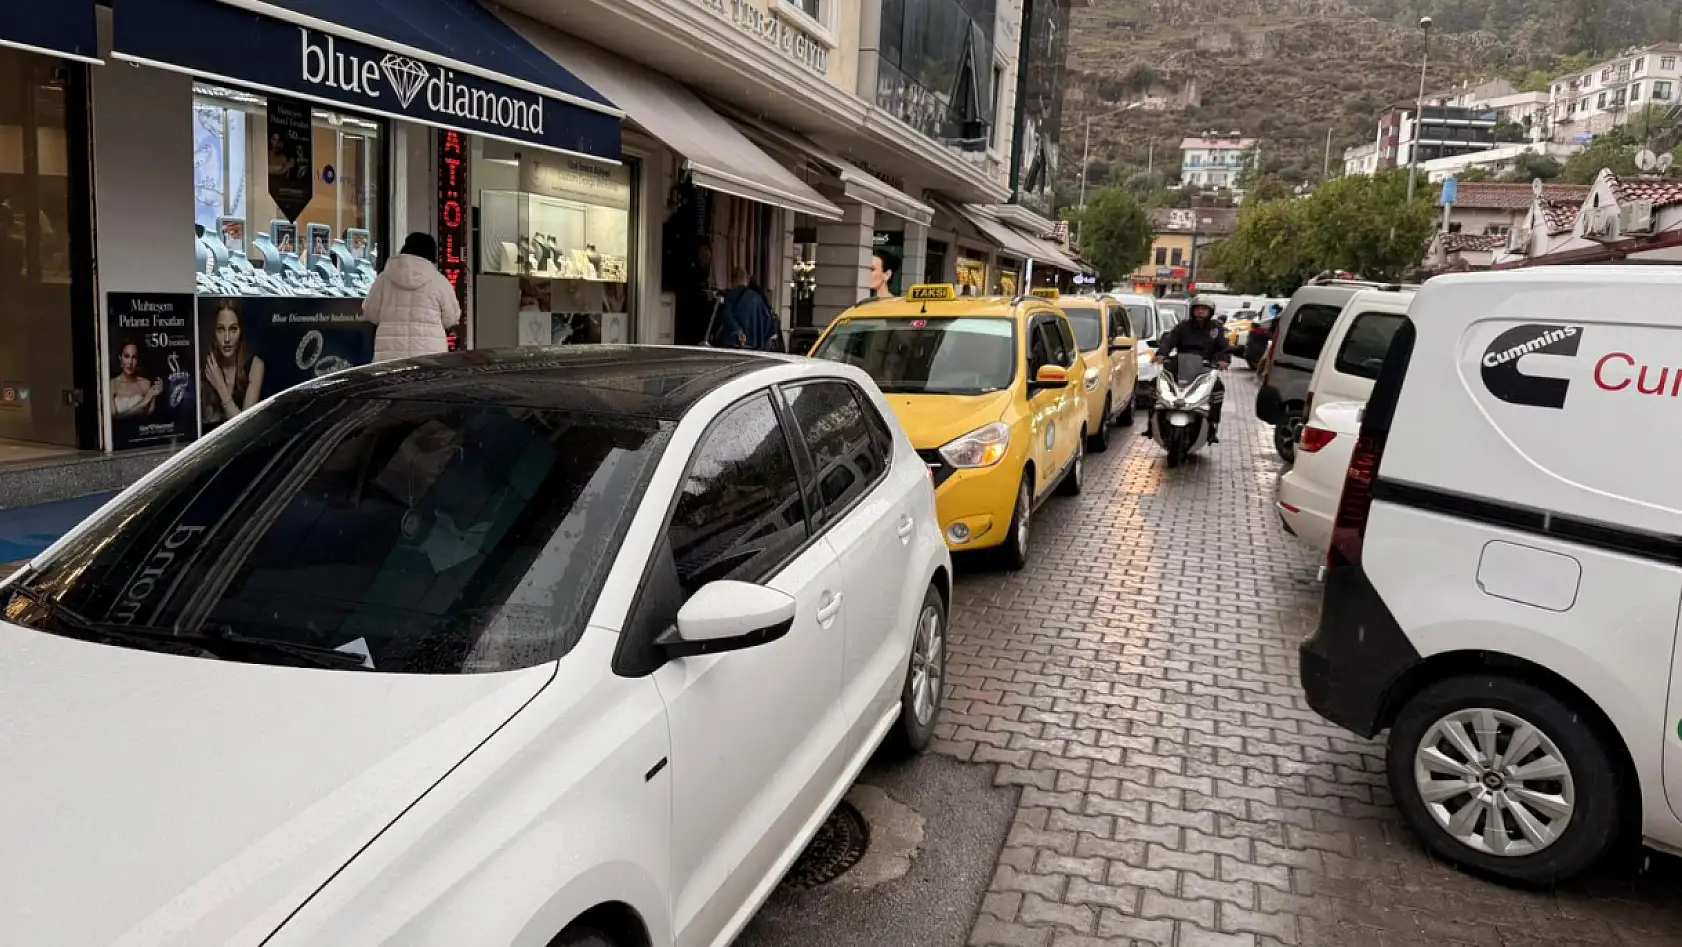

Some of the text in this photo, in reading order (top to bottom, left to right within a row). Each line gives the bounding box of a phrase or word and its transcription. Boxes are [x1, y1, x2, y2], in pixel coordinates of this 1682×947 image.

[298, 27, 544, 135] blue diamond
[1483, 324, 1577, 368] Cummins
[1593, 352, 1682, 397] Cu
